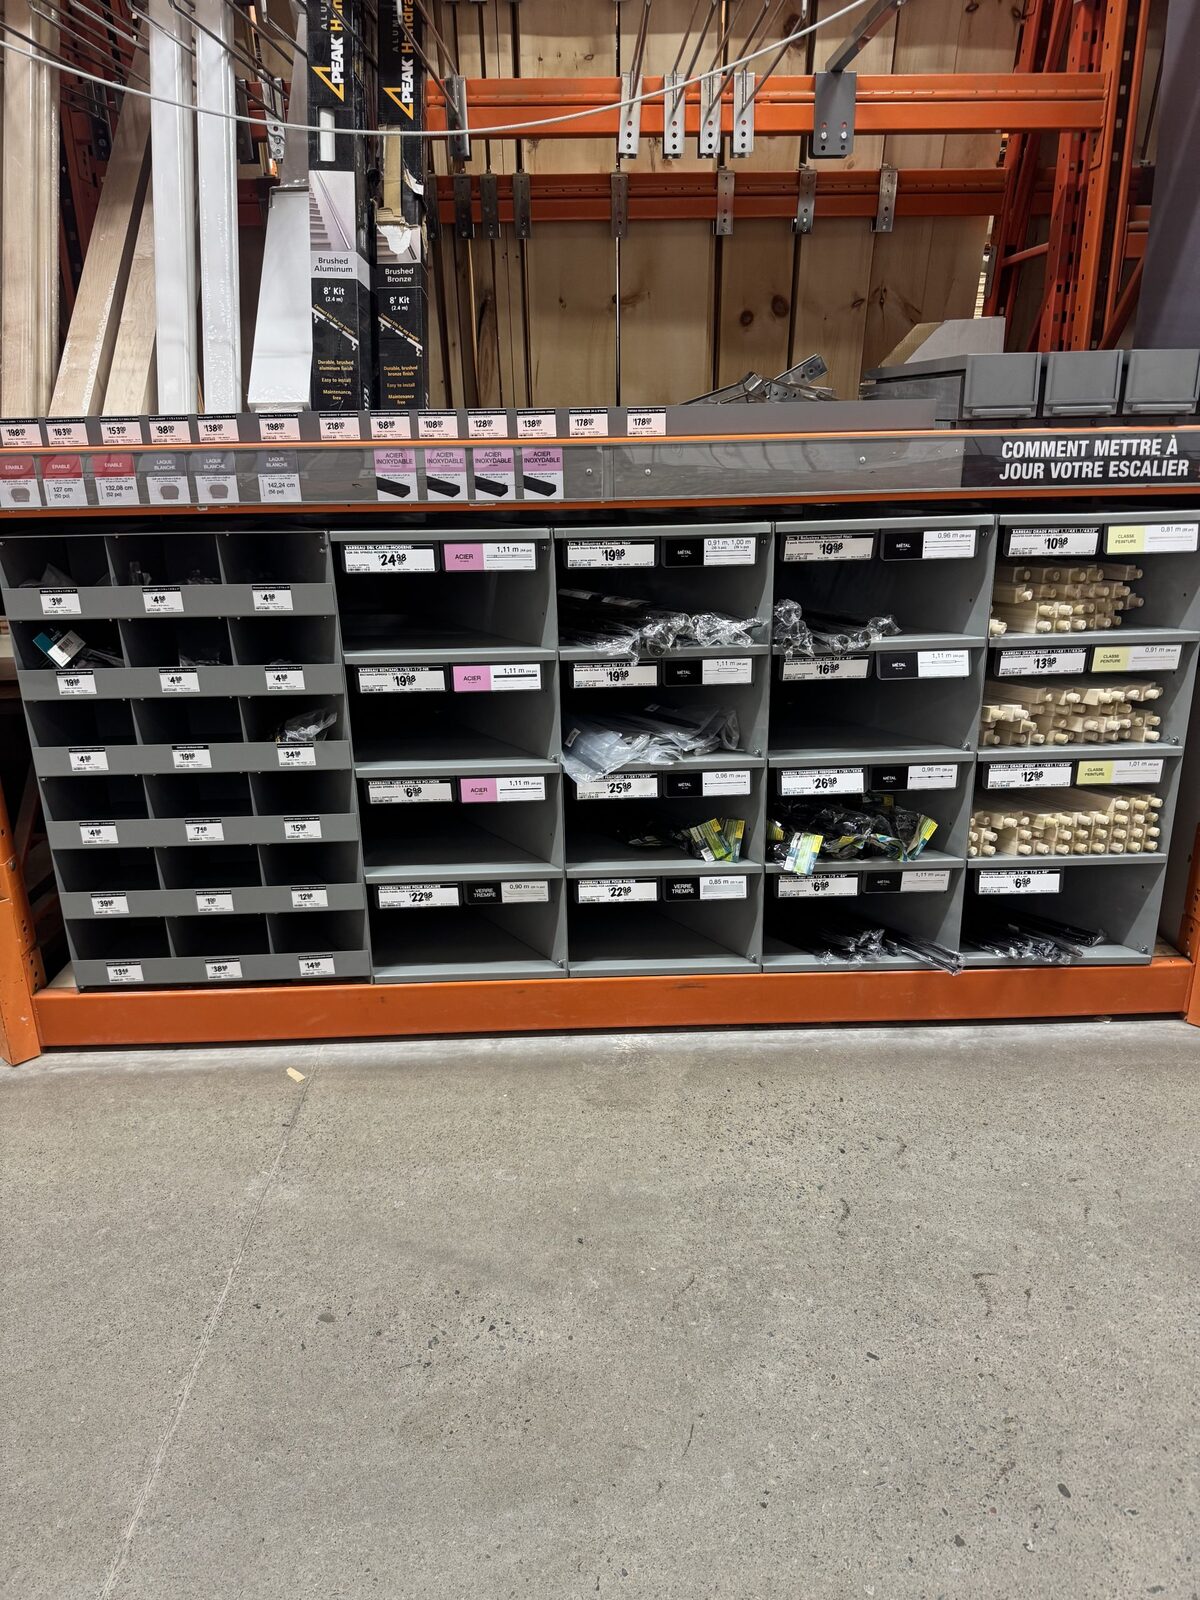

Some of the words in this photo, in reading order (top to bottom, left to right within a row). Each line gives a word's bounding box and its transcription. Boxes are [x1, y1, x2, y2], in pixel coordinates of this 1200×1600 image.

[331, 37, 344, 84] PEAK
[402, 59, 414, 104] PEAK
[333, 287, 344, 295] Kit
[1002, 440, 1090, 458] COMMENT
[1094, 438, 1162, 456] METTRE
[1165, 434, 1178, 456] À
[999, 463, 1044, 480] JOUR
[1051, 461, 1104, 479] VOTRE
[1108, 460, 1190, 478] ESCALIER
